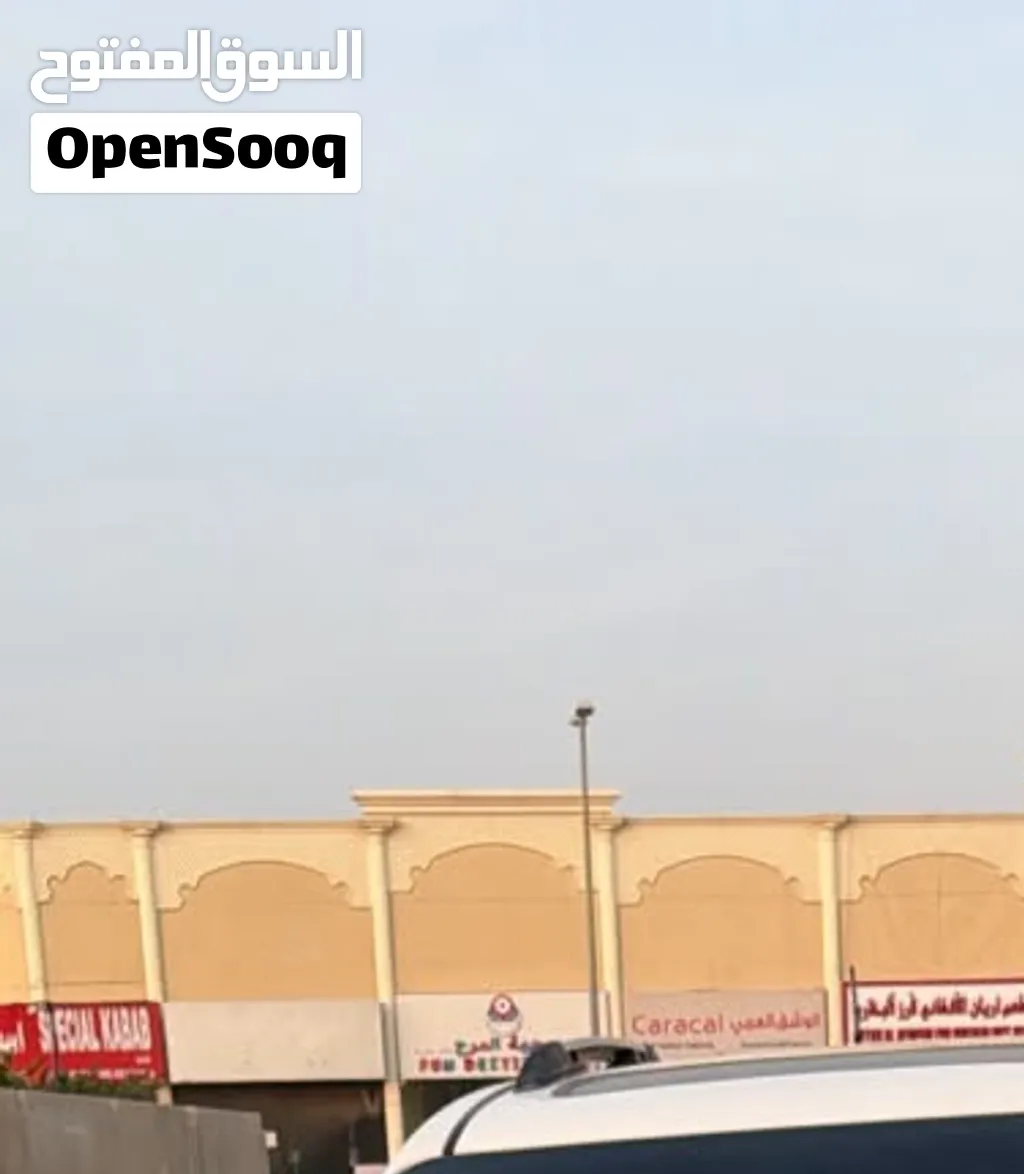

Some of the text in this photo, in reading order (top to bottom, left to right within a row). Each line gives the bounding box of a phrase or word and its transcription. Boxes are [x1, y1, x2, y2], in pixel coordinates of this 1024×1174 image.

[38, 1007, 99, 1053] SECIAL
[100, 1006, 152, 1052] KABAB
[632, 1013, 724, 1036] Caracal
